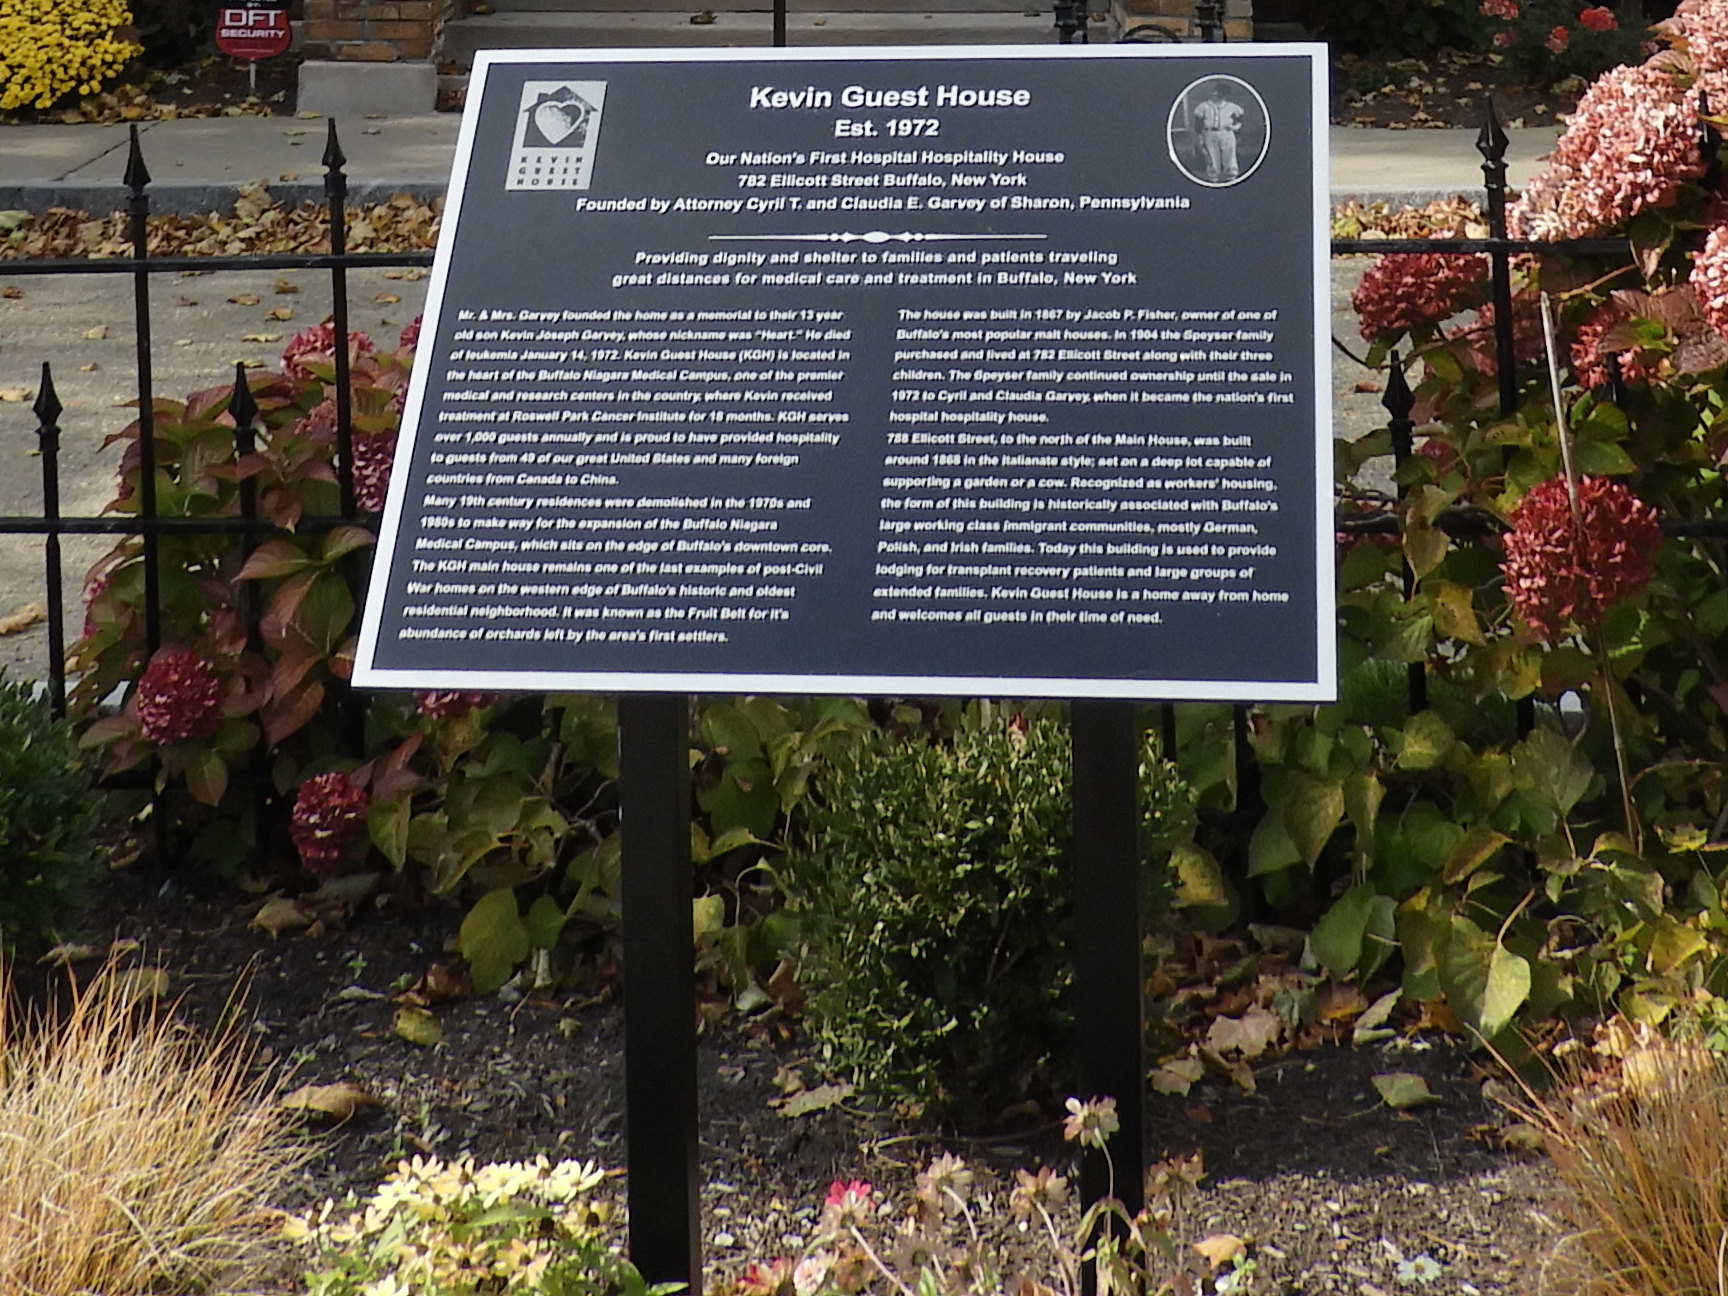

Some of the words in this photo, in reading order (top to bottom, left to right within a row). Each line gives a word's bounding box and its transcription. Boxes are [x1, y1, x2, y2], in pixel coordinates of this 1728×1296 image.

[225, 9, 282, 27] DFT
[220, 29, 285, 39] SECURITY
[749, 86, 832, 107] Kevin
[841, 85, 929, 107] Guest
[936, 84, 1030, 106] House
[834, 119, 878, 137] Est.
[885, 118, 939, 136] 1972
[705, 151, 737, 165] Our
[739, 151, 805, 165] Nation's
[809, 150, 847, 166] First
[850, 150, 918, 167] Hospital
[921, 150, 1008, 166] Hospitality
[1012, 149, 1064, 163] House
[738, 174, 767, 188] 782
[769, 173, 828, 188] Ellicott
[830, 173, 880, 187] Street
[882, 172, 946, 188] Buffalo,
[950, 172, 987, 186] New
[989, 172, 1027, 186] York
[575, 197, 647, 211] Founded
[649, 197, 671, 214] by
[672, 197, 744, 213] Attorney
[746, 196, 786, 213] Cyril
[788, 196, 802, 210] T.
[805, 196, 838, 210] and
[840, 196, 902, 210] Claudia
[906, 195, 923, 209] E.
[927, 196, 986, 212] Garvey
[989, 195, 1008, 209] of
[1010, 195, 1075, 210] Sharon,
[1079, 195, 1190, 212] Pennsylvania
[634, 251, 709, 266] Providing
[712, 251, 766, 266] dignity
[769, 250, 799, 264] and
[803, 250, 858, 264] shelter
[861, 251, 877, 264] to
[881, 250, 942, 263] families
[946, 250, 976, 263] and
[980, 250, 1044, 266] patients
[1048, 250, 1118, 265] traveling
[611, 272, 652, 287] great
[656, 272, 730, 285] distances
[734, 271, 758, 285] for
[761, 271, 822, 285] medical
[825, 273, 860, 284] care
[863, 271, 893, 285] and
[897, 271, 972, 284] treatment
[976, 271, 992, 284] in
[997, 271, 1058, 286] Buffalo,
[1063, 271, 1097, 284] New
[1100, 271, 1136, 284] York
[457, 309, 476, 321] Mr.
[478, 308, 488, 321] &
[490, 309, 516, 321] Mrs.
[518, 309, 560, 323] Garvey
[562, 309, 611, 321] founded
[612, 309, 633, 321] the
[634, 309, 668, 321] home
[669, 311, 684, 320] as
[686, 311, 695, 320] a
[696, 309, 752, 321] memorial
[753, 309, 767, 320] to
[769, 309, 798, 321] their
[799, 309, 814, 320] 13
[815, 310, 844, 322] year
[898, 308, 922, 321] The
[923, 309, 960, 320] house
[962, 310, 987, 320] was
[990, 309, 1017, 320] built
[1019, 308, 1032, 320] in
[1034, 308, 1063, 320] 1867
[1065, 309, 1081, 322] by
[1083, 309, 1121, 320] Jacob
[1123, 309, 1135, 321] P.
[1137, 309, 1178, 321] Fisher,
[1180, 311, 1220, 320] owner
[1221, 309, 1236, 320] of
[1237, 311, 1261, 320] one
[1262, 309, 1277, 320] of
[433, 432, 463, 442] over
[464, 431, 497, 444] 1,000
[497, 431, 539, 445] guests
[540, 431, 593, 445] annually
[594, 431, 618, 443] and
[619, 431, 632, 443] is
[633, 431, 671, 446] proud
[672, 431, 686, 443] to
[687, 431, 718, 443] have
[719, 430, 774, 445] provided
[775, 431, 840, 446] hospitality
[879, 518, 912, 533] large
[913, 519, 964, 533] working
[966, 519, 1000, 531] class
[1002, 519, 1067, 533] immigrant
[1068, 521, 1155, 534] communities,
[1157, 521, 1201, 535] mostly
[1202, 521, 1258, 534] German,
[412, 559, 436, 572] The
[436, 559, 467, 572] KGH
[468, 559, 500, 572] main
[501, 560, 540, 573] house
[541, 561, 592, 573] remains
[594, 563, 618, 573] one
[620, 561, 635, 574] of
[636, 561, 657, 574] the
[659, 562, 683, 574] last
[684, 562, 744, 577] examples
[746, 562, 761, 574] of
[762, 563, 823, 577] post-Civil
[873, 585, 932, 598] extended
[934, 586, 988, 599] families.
[990, 586, 1028, 599] Kevin
[1029, 587, 1069, 600] Guest
[1071, 587, 1113, 600] House
[1116, 588, 1128, 600] is
[1131, 590, 1140, 600] a
[1142, 588, 1179, 600] home
[1181, 590, 1215, 603] away
[1218, 589, 1249, 601] from
[1252, 590, 1289, 602] home
